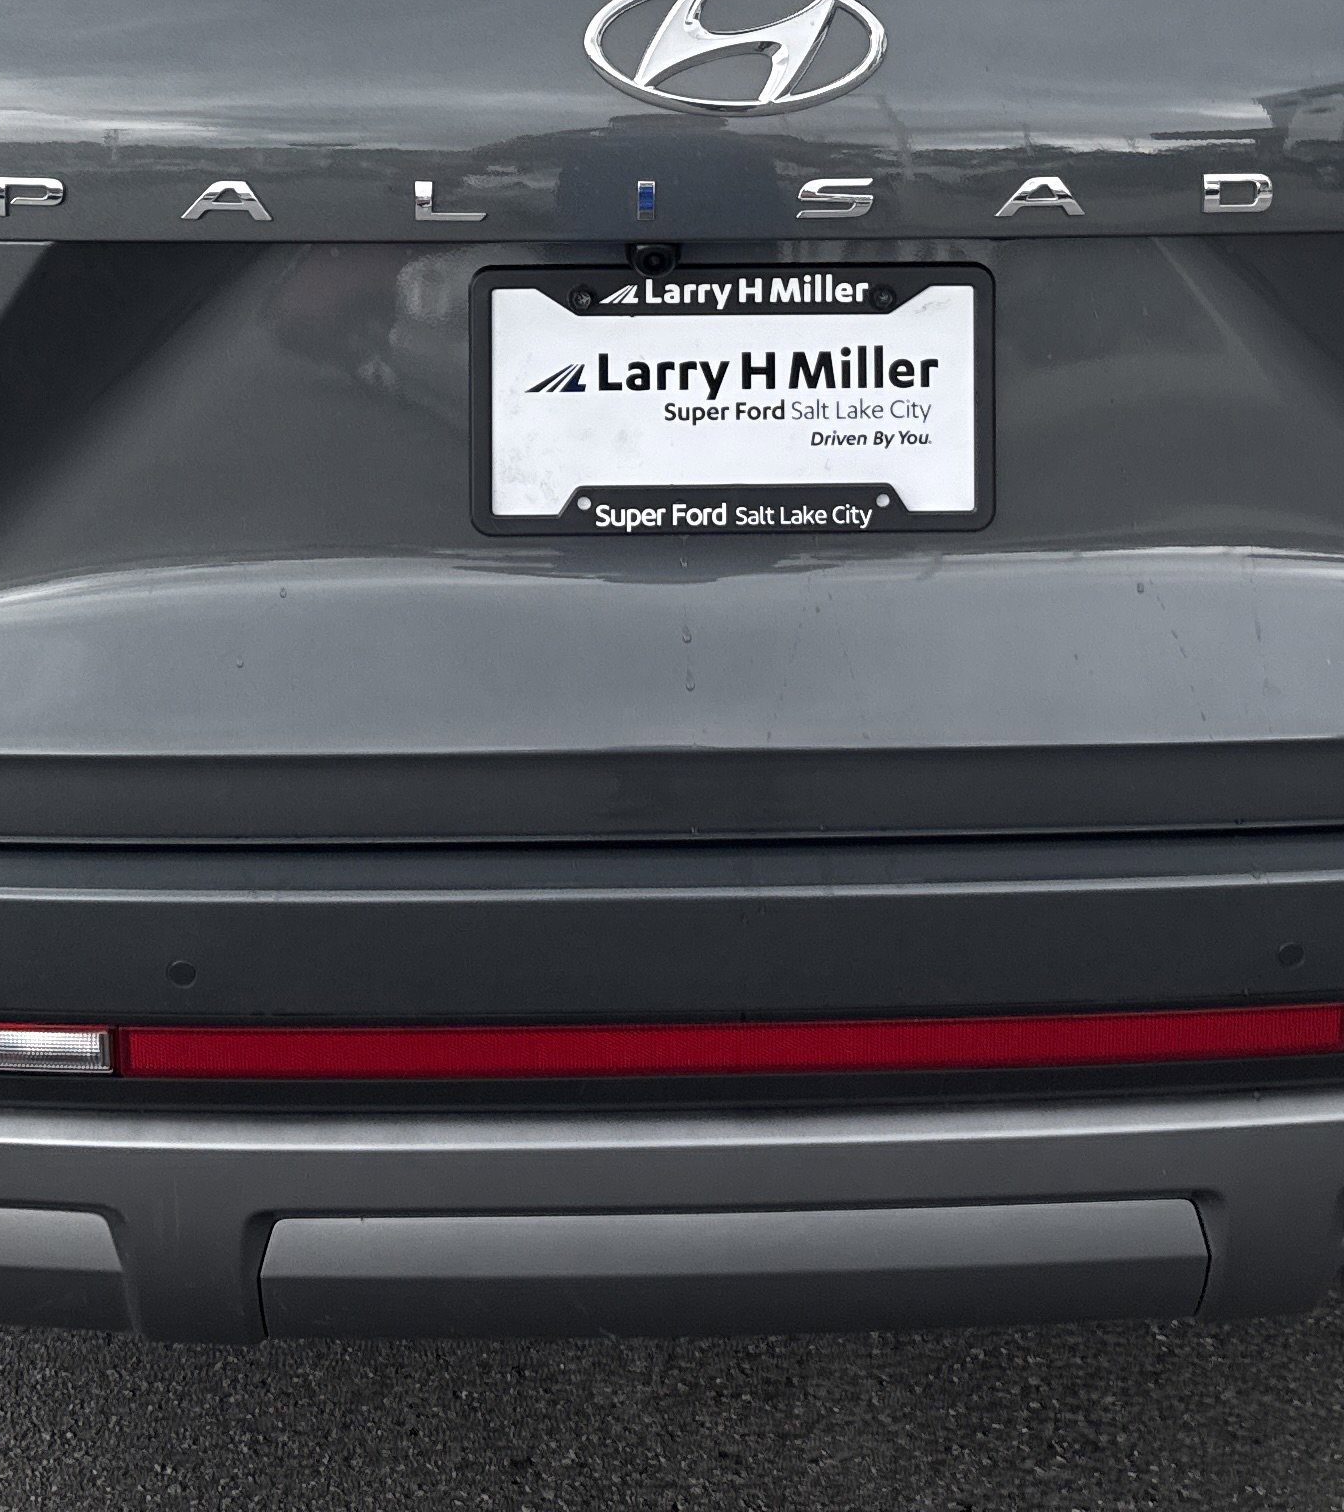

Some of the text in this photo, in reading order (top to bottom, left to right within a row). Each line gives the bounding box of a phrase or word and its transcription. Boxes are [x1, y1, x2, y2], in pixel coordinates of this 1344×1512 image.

[645, 274, 869, 310] Larry H Miller
[598, 345, 939, 400] Larry H Miller
[664, 398, 932, 426] Super Ford Salt Lake City
[810, 430, 868, 447] Driven
[873, 431, 895, 449] By
[595, 503, 873, 532] Super Ford Salt Lake City
